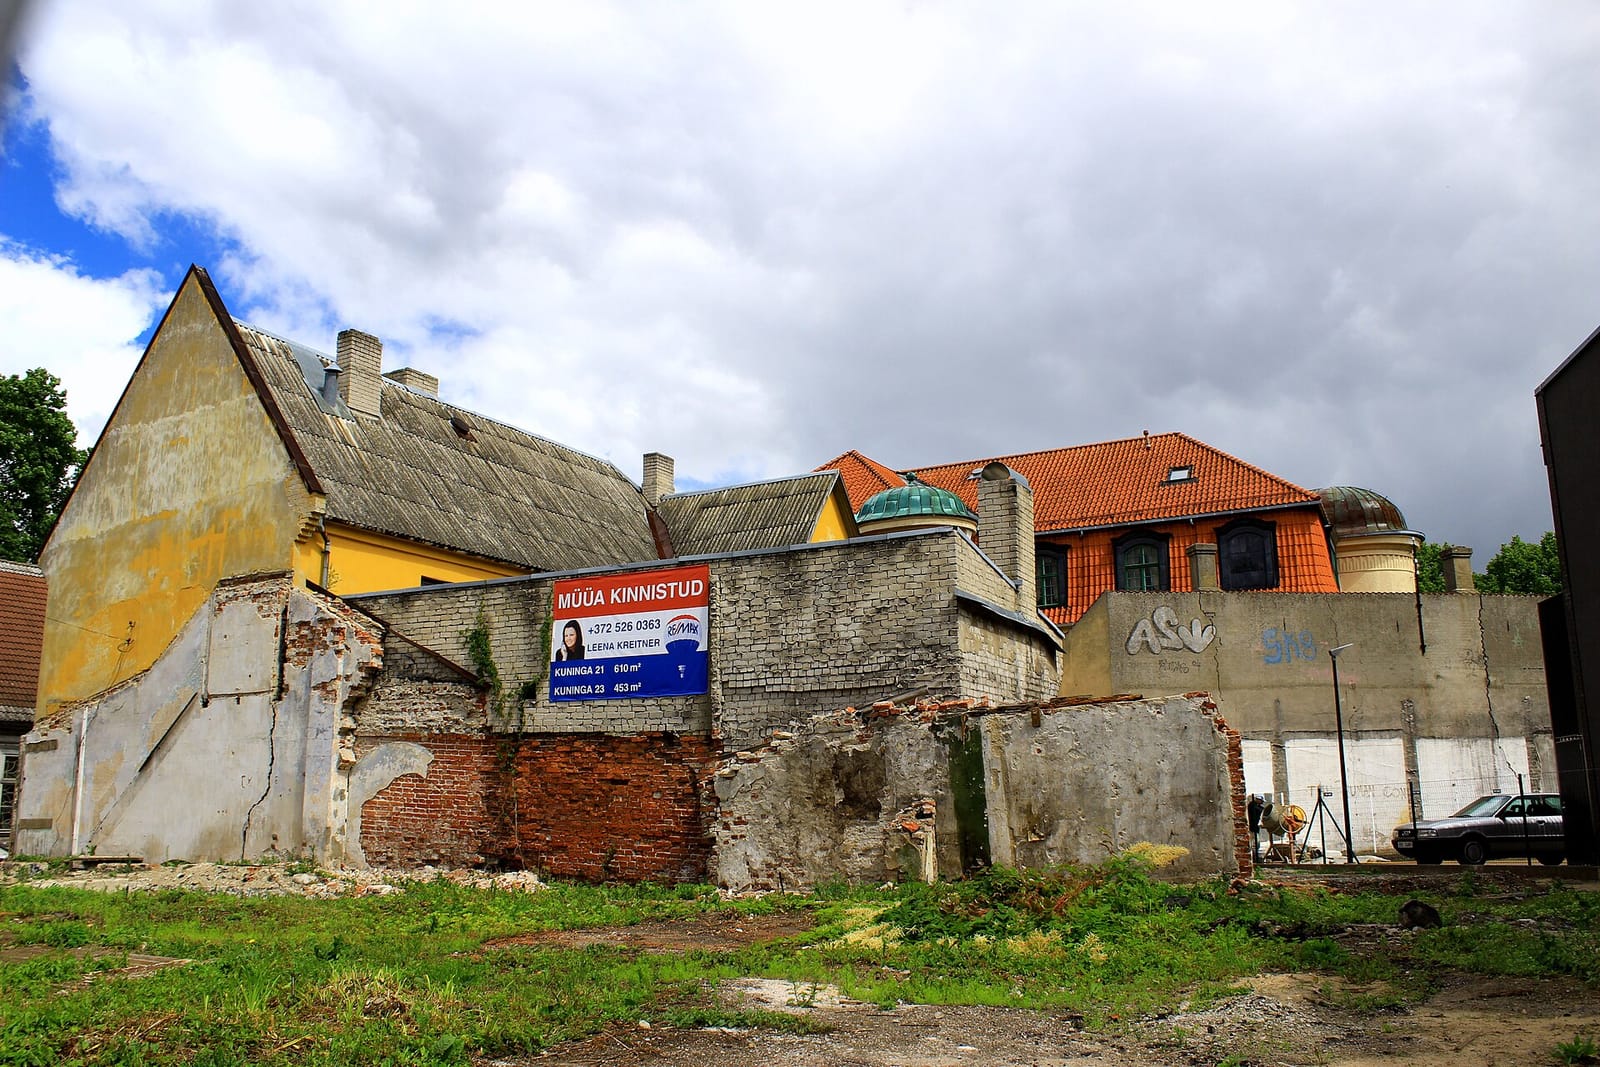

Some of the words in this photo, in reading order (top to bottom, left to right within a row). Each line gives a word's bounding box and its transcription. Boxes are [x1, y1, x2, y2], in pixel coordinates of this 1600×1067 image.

[558, 587, 605, 609] MÜÜA
[610, 580, 704, 604] KINNISTUD
[588, 623, 612, 635] +372
[614, 621, 633, 633] 526
[636, 618, 661, 631] 0363
[587, 642, 615, 652] LEENA
[617, 638, 660, 650] KREITNER
[554, 666, 593, 677] KUNINGA
[594, 665, 605, 674] 21
[614, 664, 628, 673] 610
[554, 685, 593, 696] KUNINGA
[594, 684, 605, 694] 23
[613, 683, 629, 693] 453
